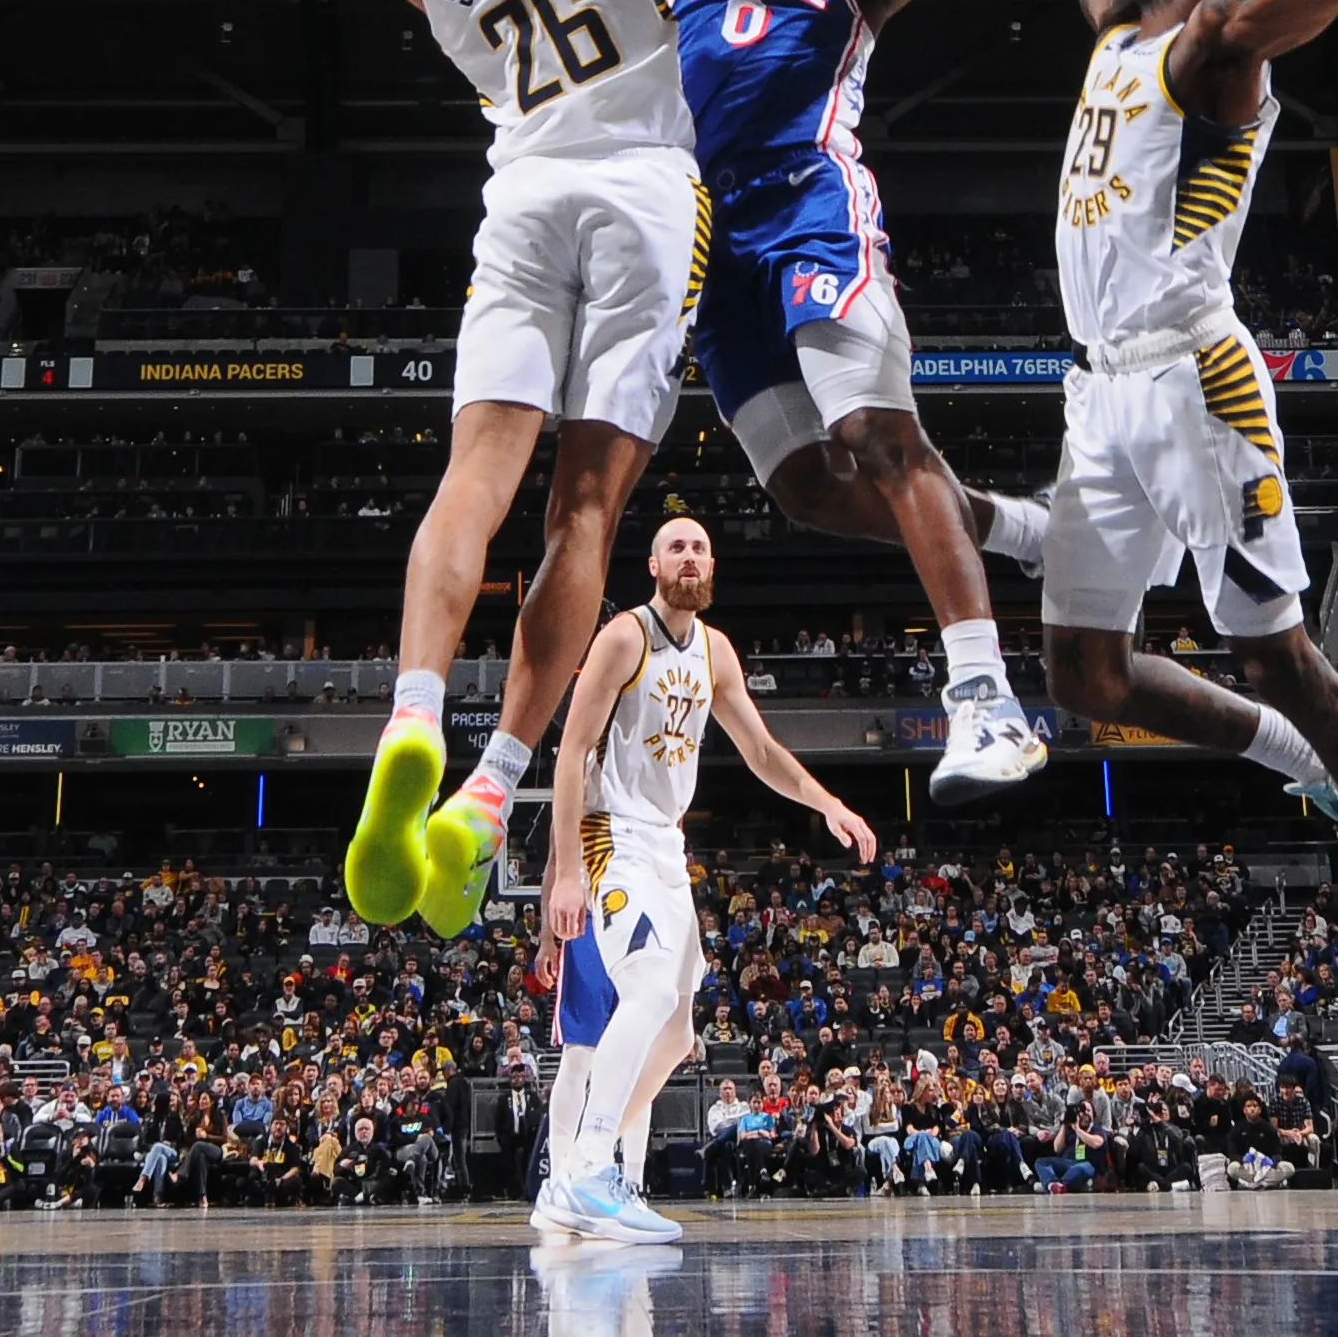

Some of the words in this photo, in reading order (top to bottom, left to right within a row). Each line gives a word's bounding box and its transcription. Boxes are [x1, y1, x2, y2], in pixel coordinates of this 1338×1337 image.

[1069, 108, 1118, 177] 29
[791, 275, 839, 306] 76
[140, 364, 222, 381] INDIANA
[226, 363, 304, 381] PACERS
[401, 360, 433, 381] 40
[912, 358, 1008, 377] ADELPHIA
[1013, 358, 1072, 377] 76ERS
[42, 369, 55, 386] 4
[648, 666, 706, 709] INDIANA
[451, 712, 500, 727] PACERS
[664, 694, 693, 739] 32
[166, 721, 236, 741] RYAN
[468, 732, 489, 749] 40
[12, 744, 63, 753] HENSLEY.
